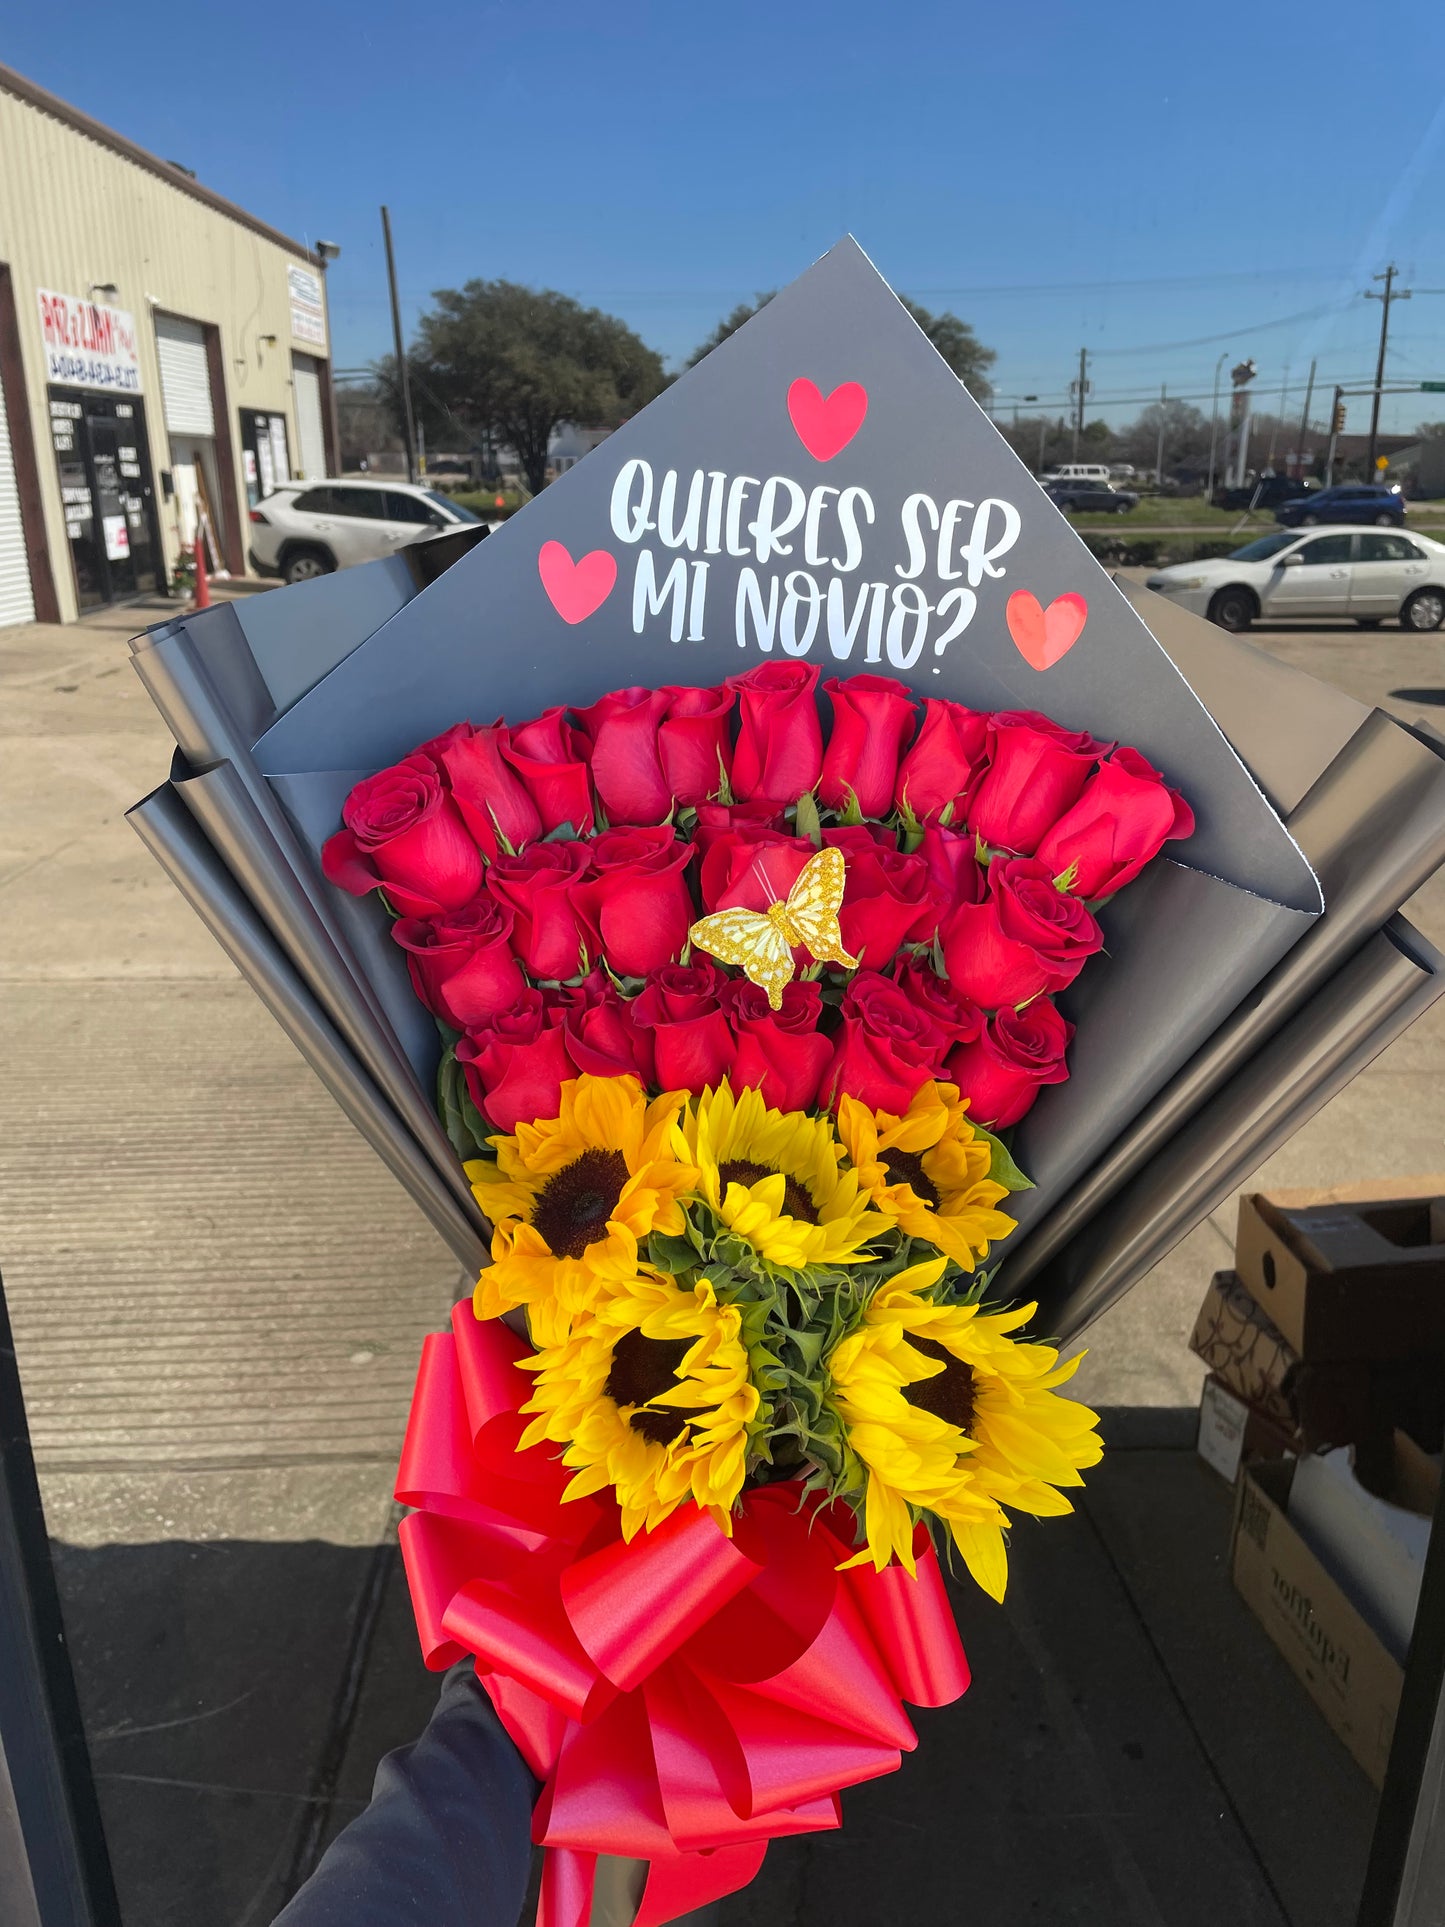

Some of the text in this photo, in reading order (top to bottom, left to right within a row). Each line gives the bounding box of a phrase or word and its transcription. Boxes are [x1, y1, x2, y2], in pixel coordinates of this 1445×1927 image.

[610, 459, 1022, 587] QUIERES SER
[632, 549, 978, 674] MI NOVIO?
